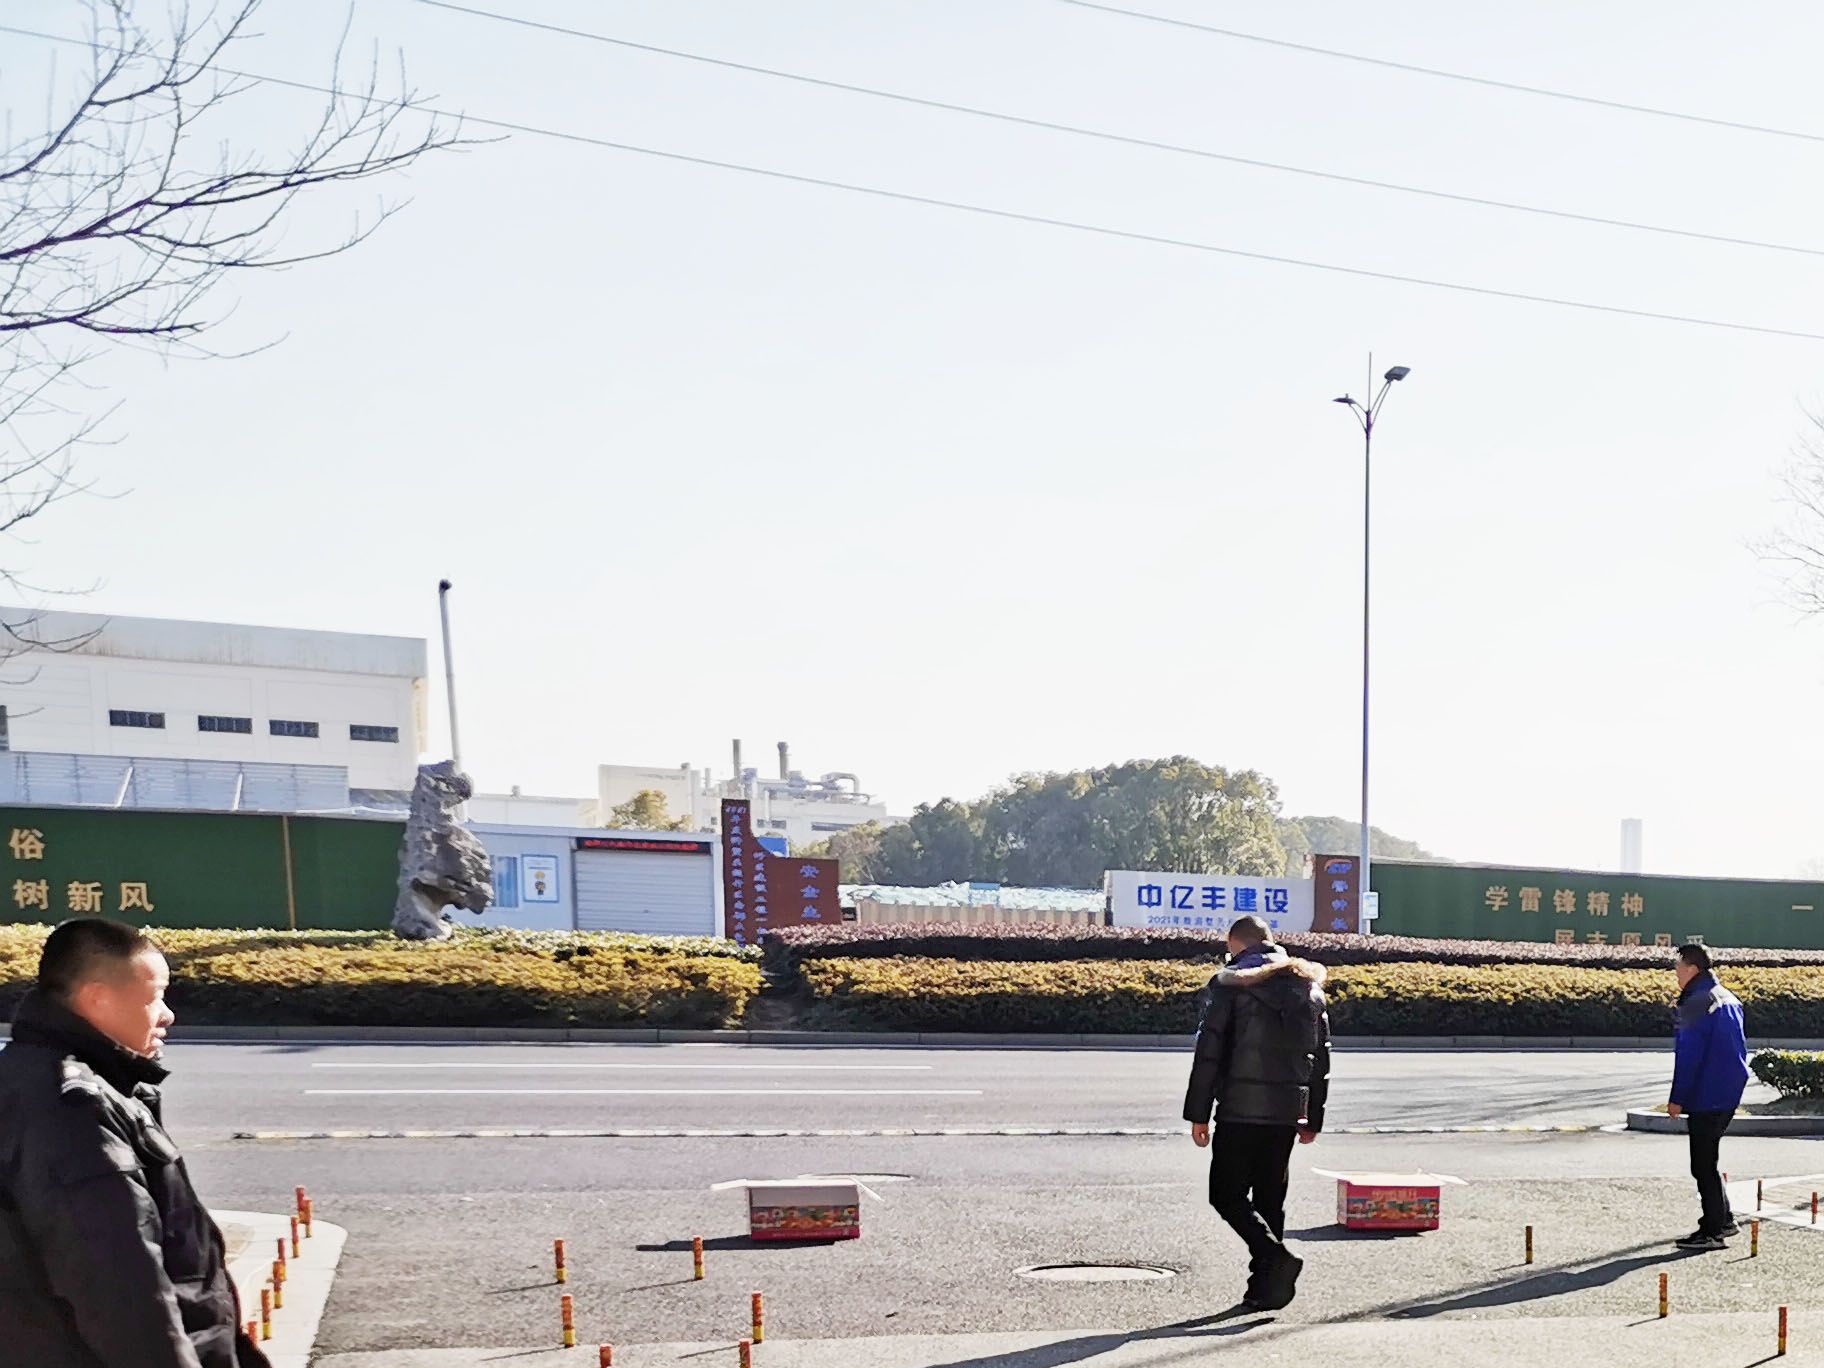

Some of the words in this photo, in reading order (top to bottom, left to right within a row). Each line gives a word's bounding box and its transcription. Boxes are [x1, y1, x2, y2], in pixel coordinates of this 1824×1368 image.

[8, 827, 46, 860] 俗
[12, 878, 155, 913] 树新风
[1136, 883, 1289, 914] 中亿丰建设
[1485, 885, 1645, 917] 学雷锋精神
